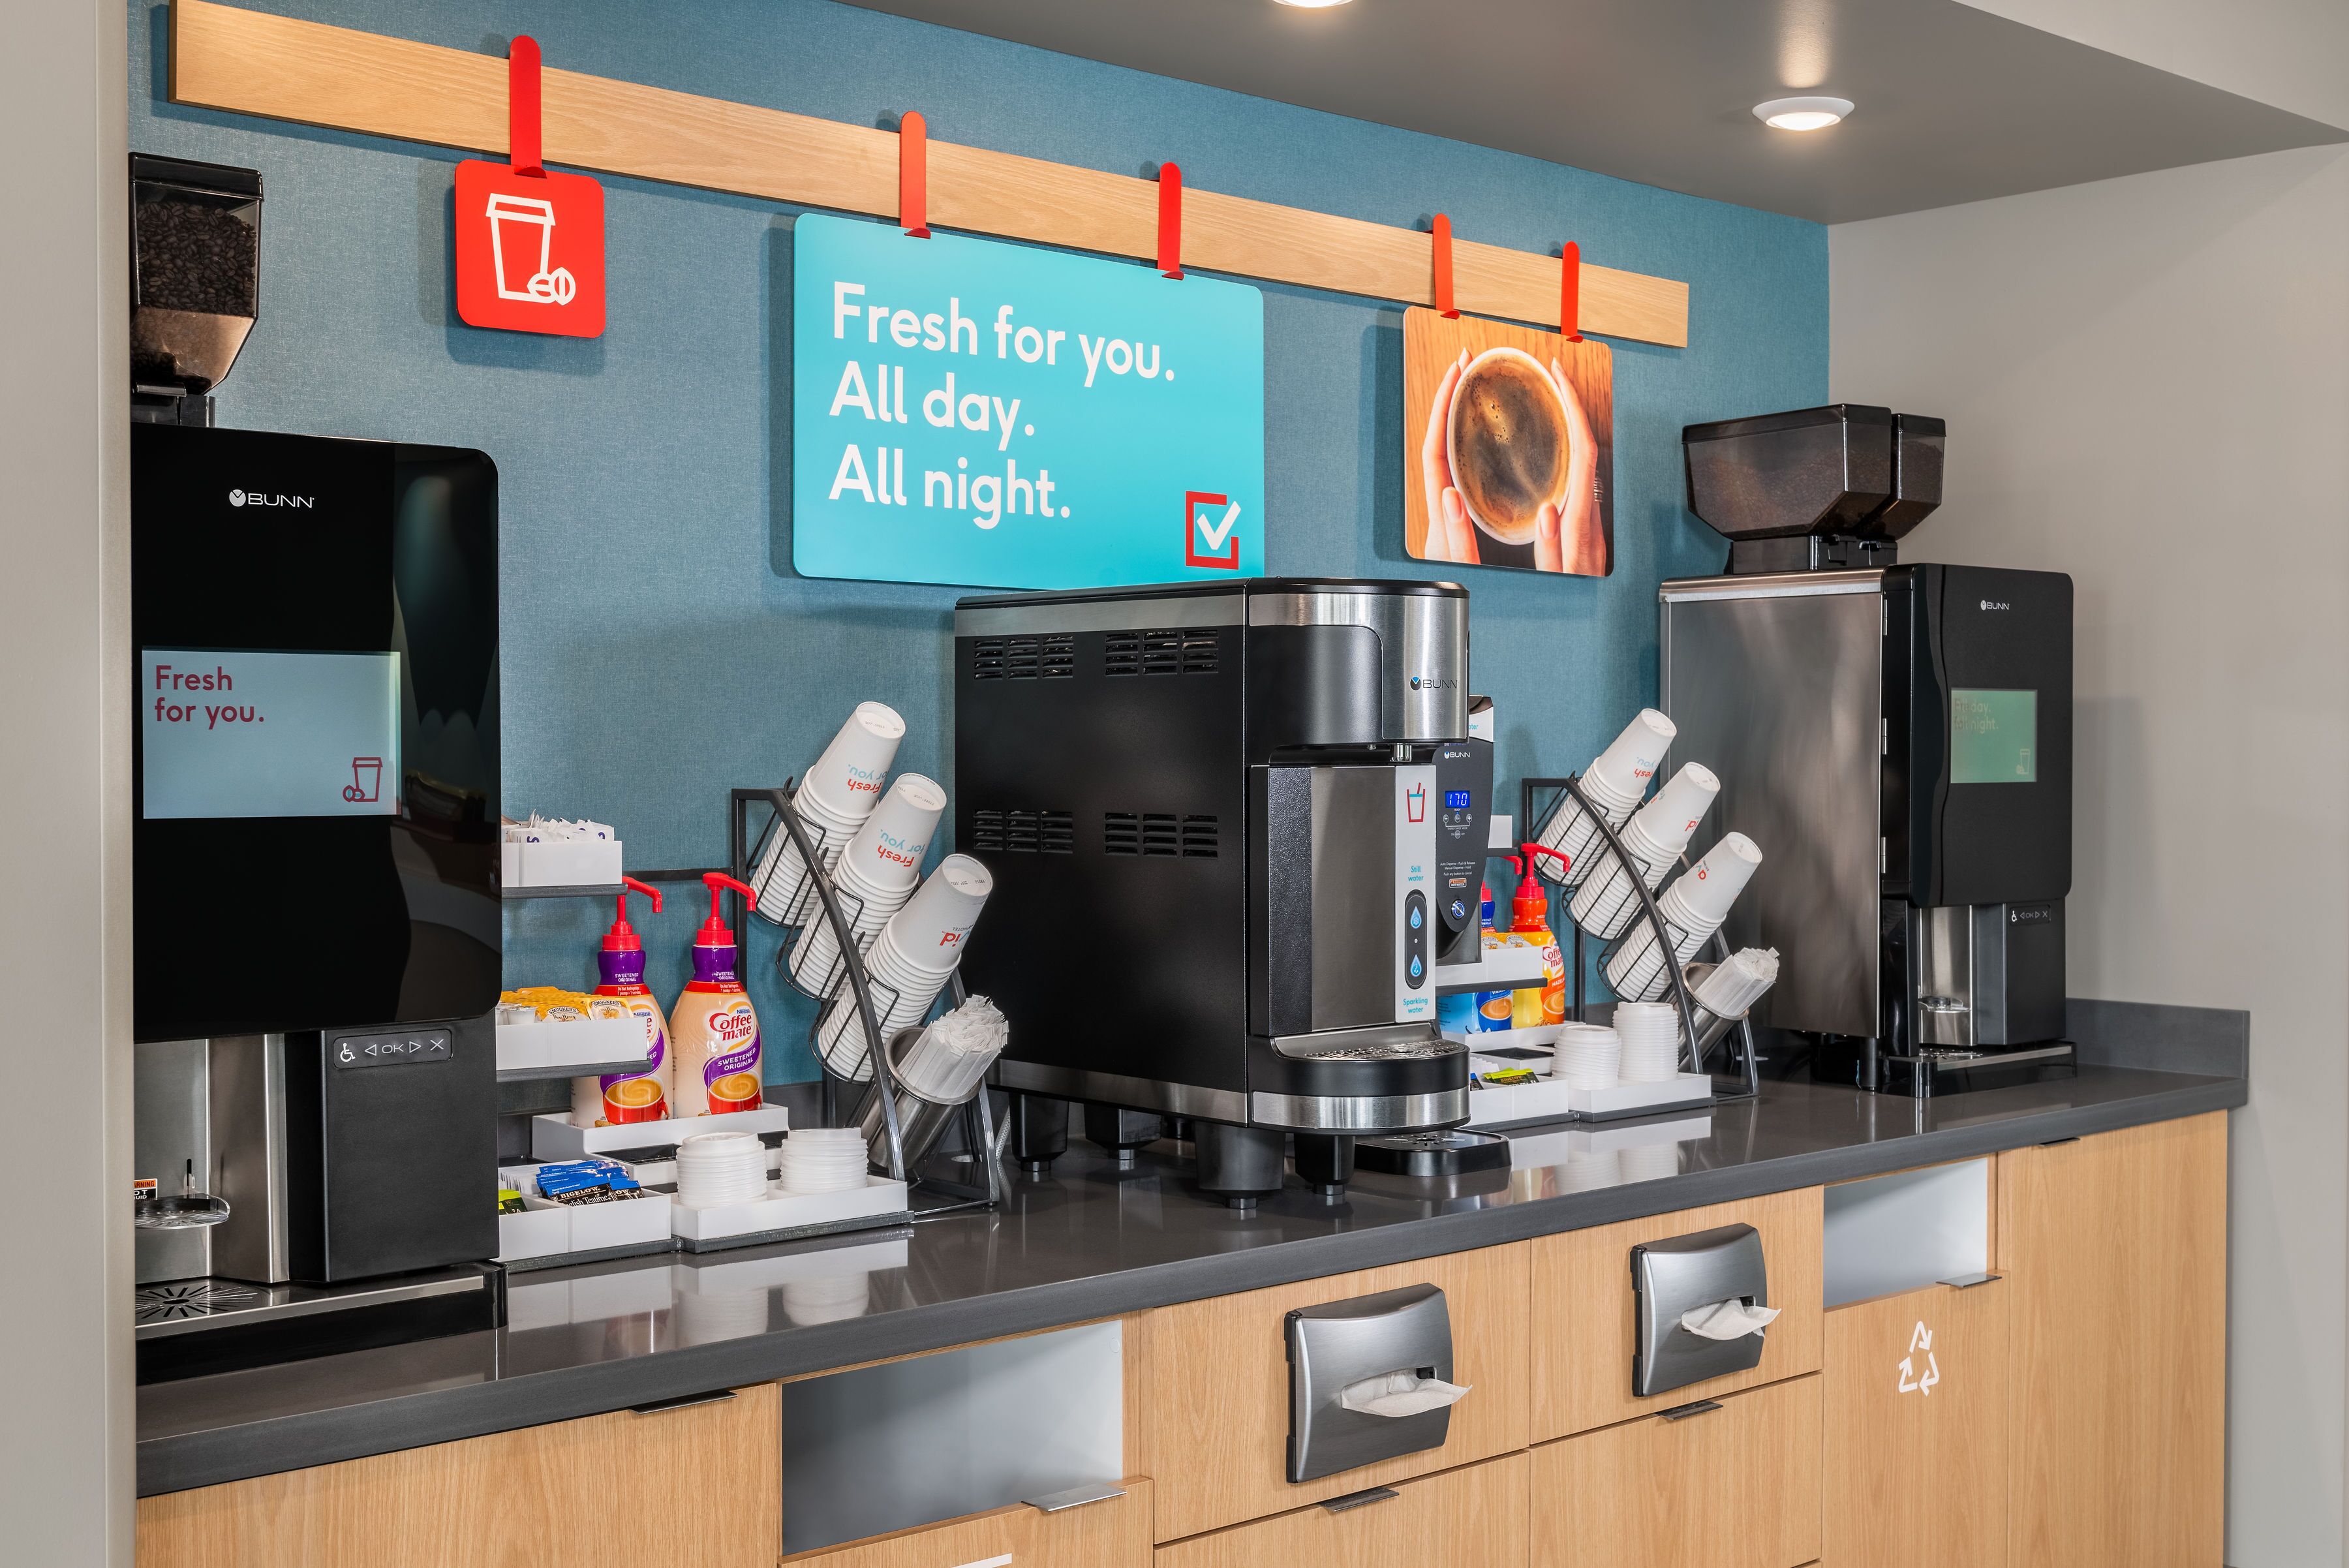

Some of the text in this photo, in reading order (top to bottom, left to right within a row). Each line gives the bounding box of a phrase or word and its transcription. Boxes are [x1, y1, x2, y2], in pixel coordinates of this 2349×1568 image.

[834, 281, 1174, 388] Fresh for you.
[829, 360, 1035, 452] All day.
[828, 444, 1070, 530] All night.
[248, 493, 313, 508] BUNN
[1987, 602, 2009, 610] BUNN
[156, 666, 232, 690] Fresh
[1423, 679, 1457, 688] BUNN
[155, 697, 264, 730] for you.
[848, 764, 874, 780] you.
[876, 771, 887, 780] or
[847, 778, 882, 793] Fresh
[1449, 793, 1467, 806] 170
[881, 829, 906, 850] you.
[877, 845, 914, 867] Fresh
[1403, 997, 1428, 1007] Sparkling
[709, 1012, 752, 1032] Coffee
[722, 1025, 752, 1041] mate
[382, 1043, 404, 1054] OK
[718, 1047, 756, 1067] SWEETENED
[724, 1057, 754, 1071] ORIGINAL
